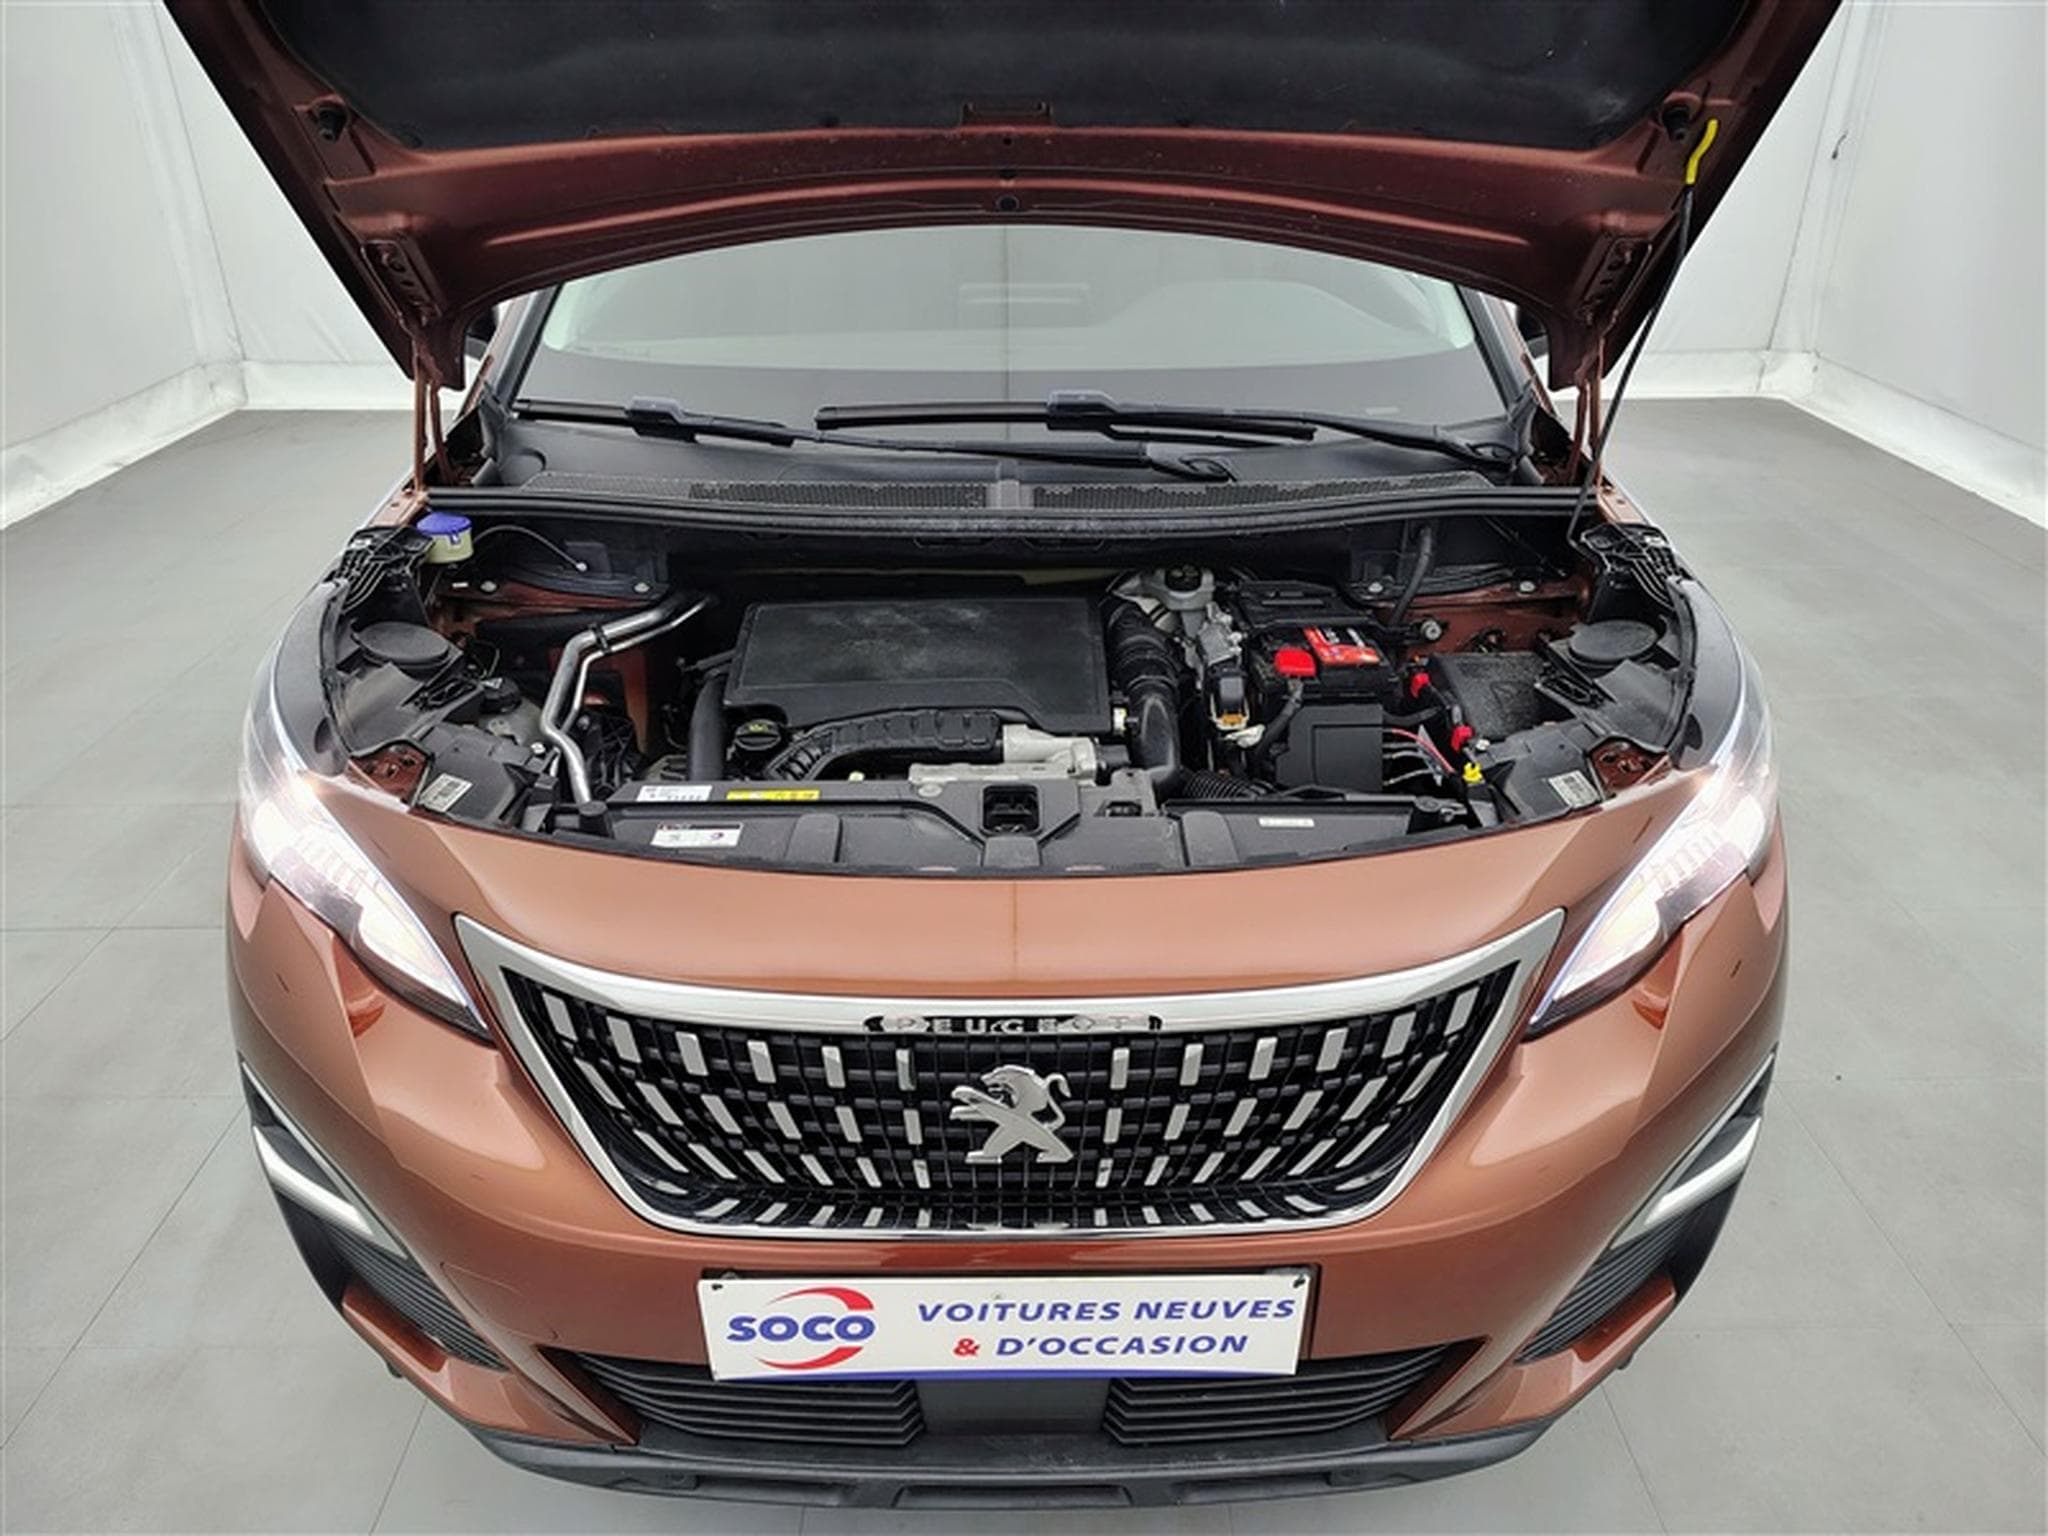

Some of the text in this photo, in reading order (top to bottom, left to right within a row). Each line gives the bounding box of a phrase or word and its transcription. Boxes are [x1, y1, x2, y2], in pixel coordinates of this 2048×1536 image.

[917, 1300, 1295, 1322] VOITURES NEUVES
[727, 1315, 876, 1342] SOCO
[953, 1335, 1249, 1356] & D'OCCASION
